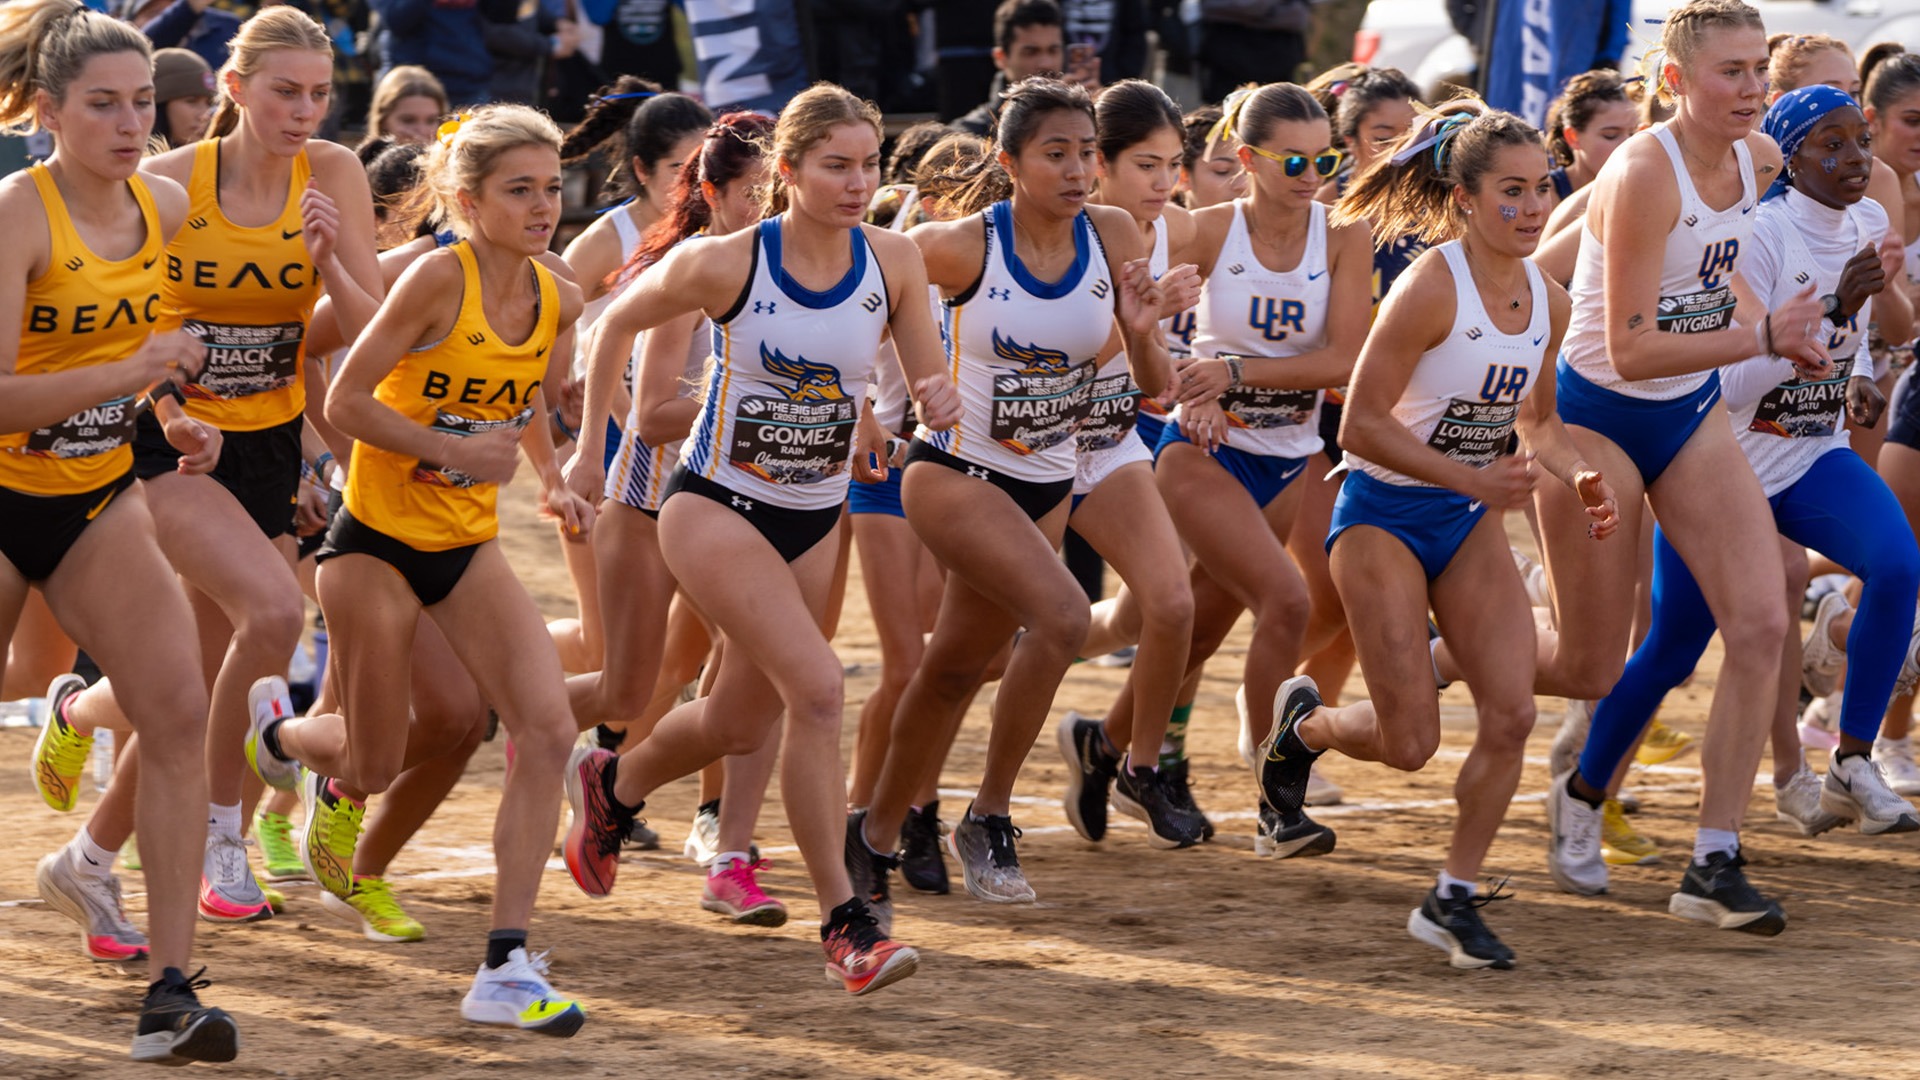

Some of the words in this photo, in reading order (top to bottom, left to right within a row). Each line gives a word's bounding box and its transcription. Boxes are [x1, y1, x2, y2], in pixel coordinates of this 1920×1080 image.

[1697, 237, 1739, 289] UCR
[1675, 296, 1695, 305] THE
[1695, 293, 1710, 304] BIG
[1710, 289, 1728, 302] WEST
[1683, 303, 1701, 313] CROSS
[1701, 299, 1722, 311] COUNTRY
[1249, 296, 1305, 341] UCR
[1670, 310, 1725, 333] NYGREN
[207, 325, 231, 336] THE
[1171, 312, 1197, 346] UC
[210, 347, 274, 365] HACK
[1020, 377, 1043, 388] THE
[998, 382, 1092, 419] MARTINEZ
[1780, 382, 1846, 404] N'DIAYE
[62, 403, 125, 427] JONES
[766, 401, 788, 413] THE
[789, 403, 810, 416] BIG
[810, 403, 837, 416] WEST
[772, 412, 797, 423] CROSS
[798, 414, 831, 424] COUNTRY
[757, 425, 838, 446] GOMEZ
[1438, 421, 1514, 441] LOWENGRU
[780, 445, 806, 456] RAIN
[754, 451, 831, 472] Championships
